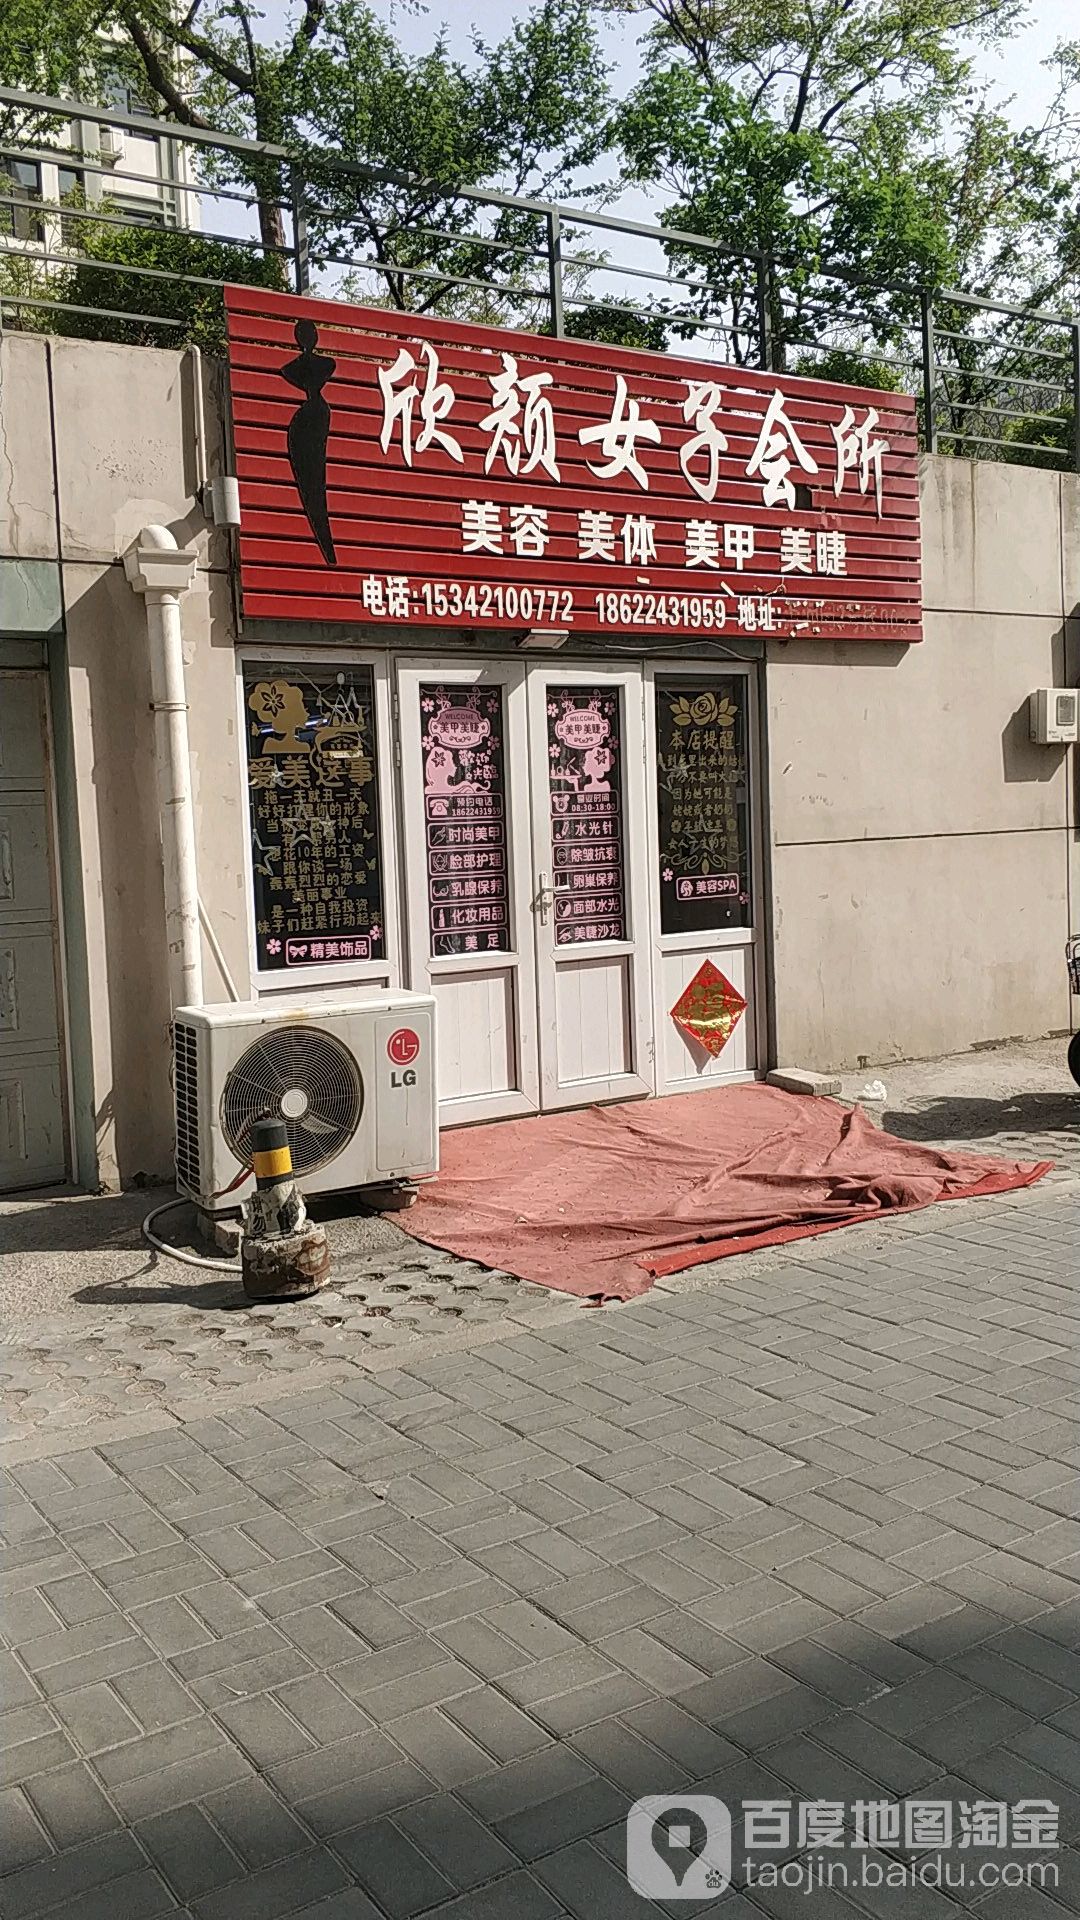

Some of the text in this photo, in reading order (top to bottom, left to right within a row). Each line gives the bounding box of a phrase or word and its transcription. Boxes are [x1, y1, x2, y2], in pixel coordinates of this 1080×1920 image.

[378, 341, 890, 519] 欣颜女子会所
[461, 499, 847, 576] 美容 美体 美甲 美睫
[596, 592, 726, 629] 18622431959
[440, 722, 480, 734] 美甲美睫
[565, 723, 601, 735] 美甲美睫
[668, 729, 735, 750] 本店提醒
[266, 815, 364, 833] 当你变成神后
[574, 820, 614, 836] 水光针
[448, 826, 500, 842] 时尚美甲
[449, 853, 501, 870] 脸部护理
[571, 846, 617, 863] 除皱抗衰
[283, 858, 352, 875] 跟你谈一场
[269, 870, 367, 890] 轰轰烈烈的恋爱
[451, 879, 502, 897] 乳腺保养
[573, 872, 618, 889] 卵巢保养
[271, 898, 368, 919] 是一种自我投资
[573, 897, 620, 914] 面部水光
[452, 906, 503, 924] 化妆用品
[574, 923, 621, 941] 美睫沙龙
[310, 941, 368, 958] 精美饰品
[390, 1069, 416, 1088] LG
